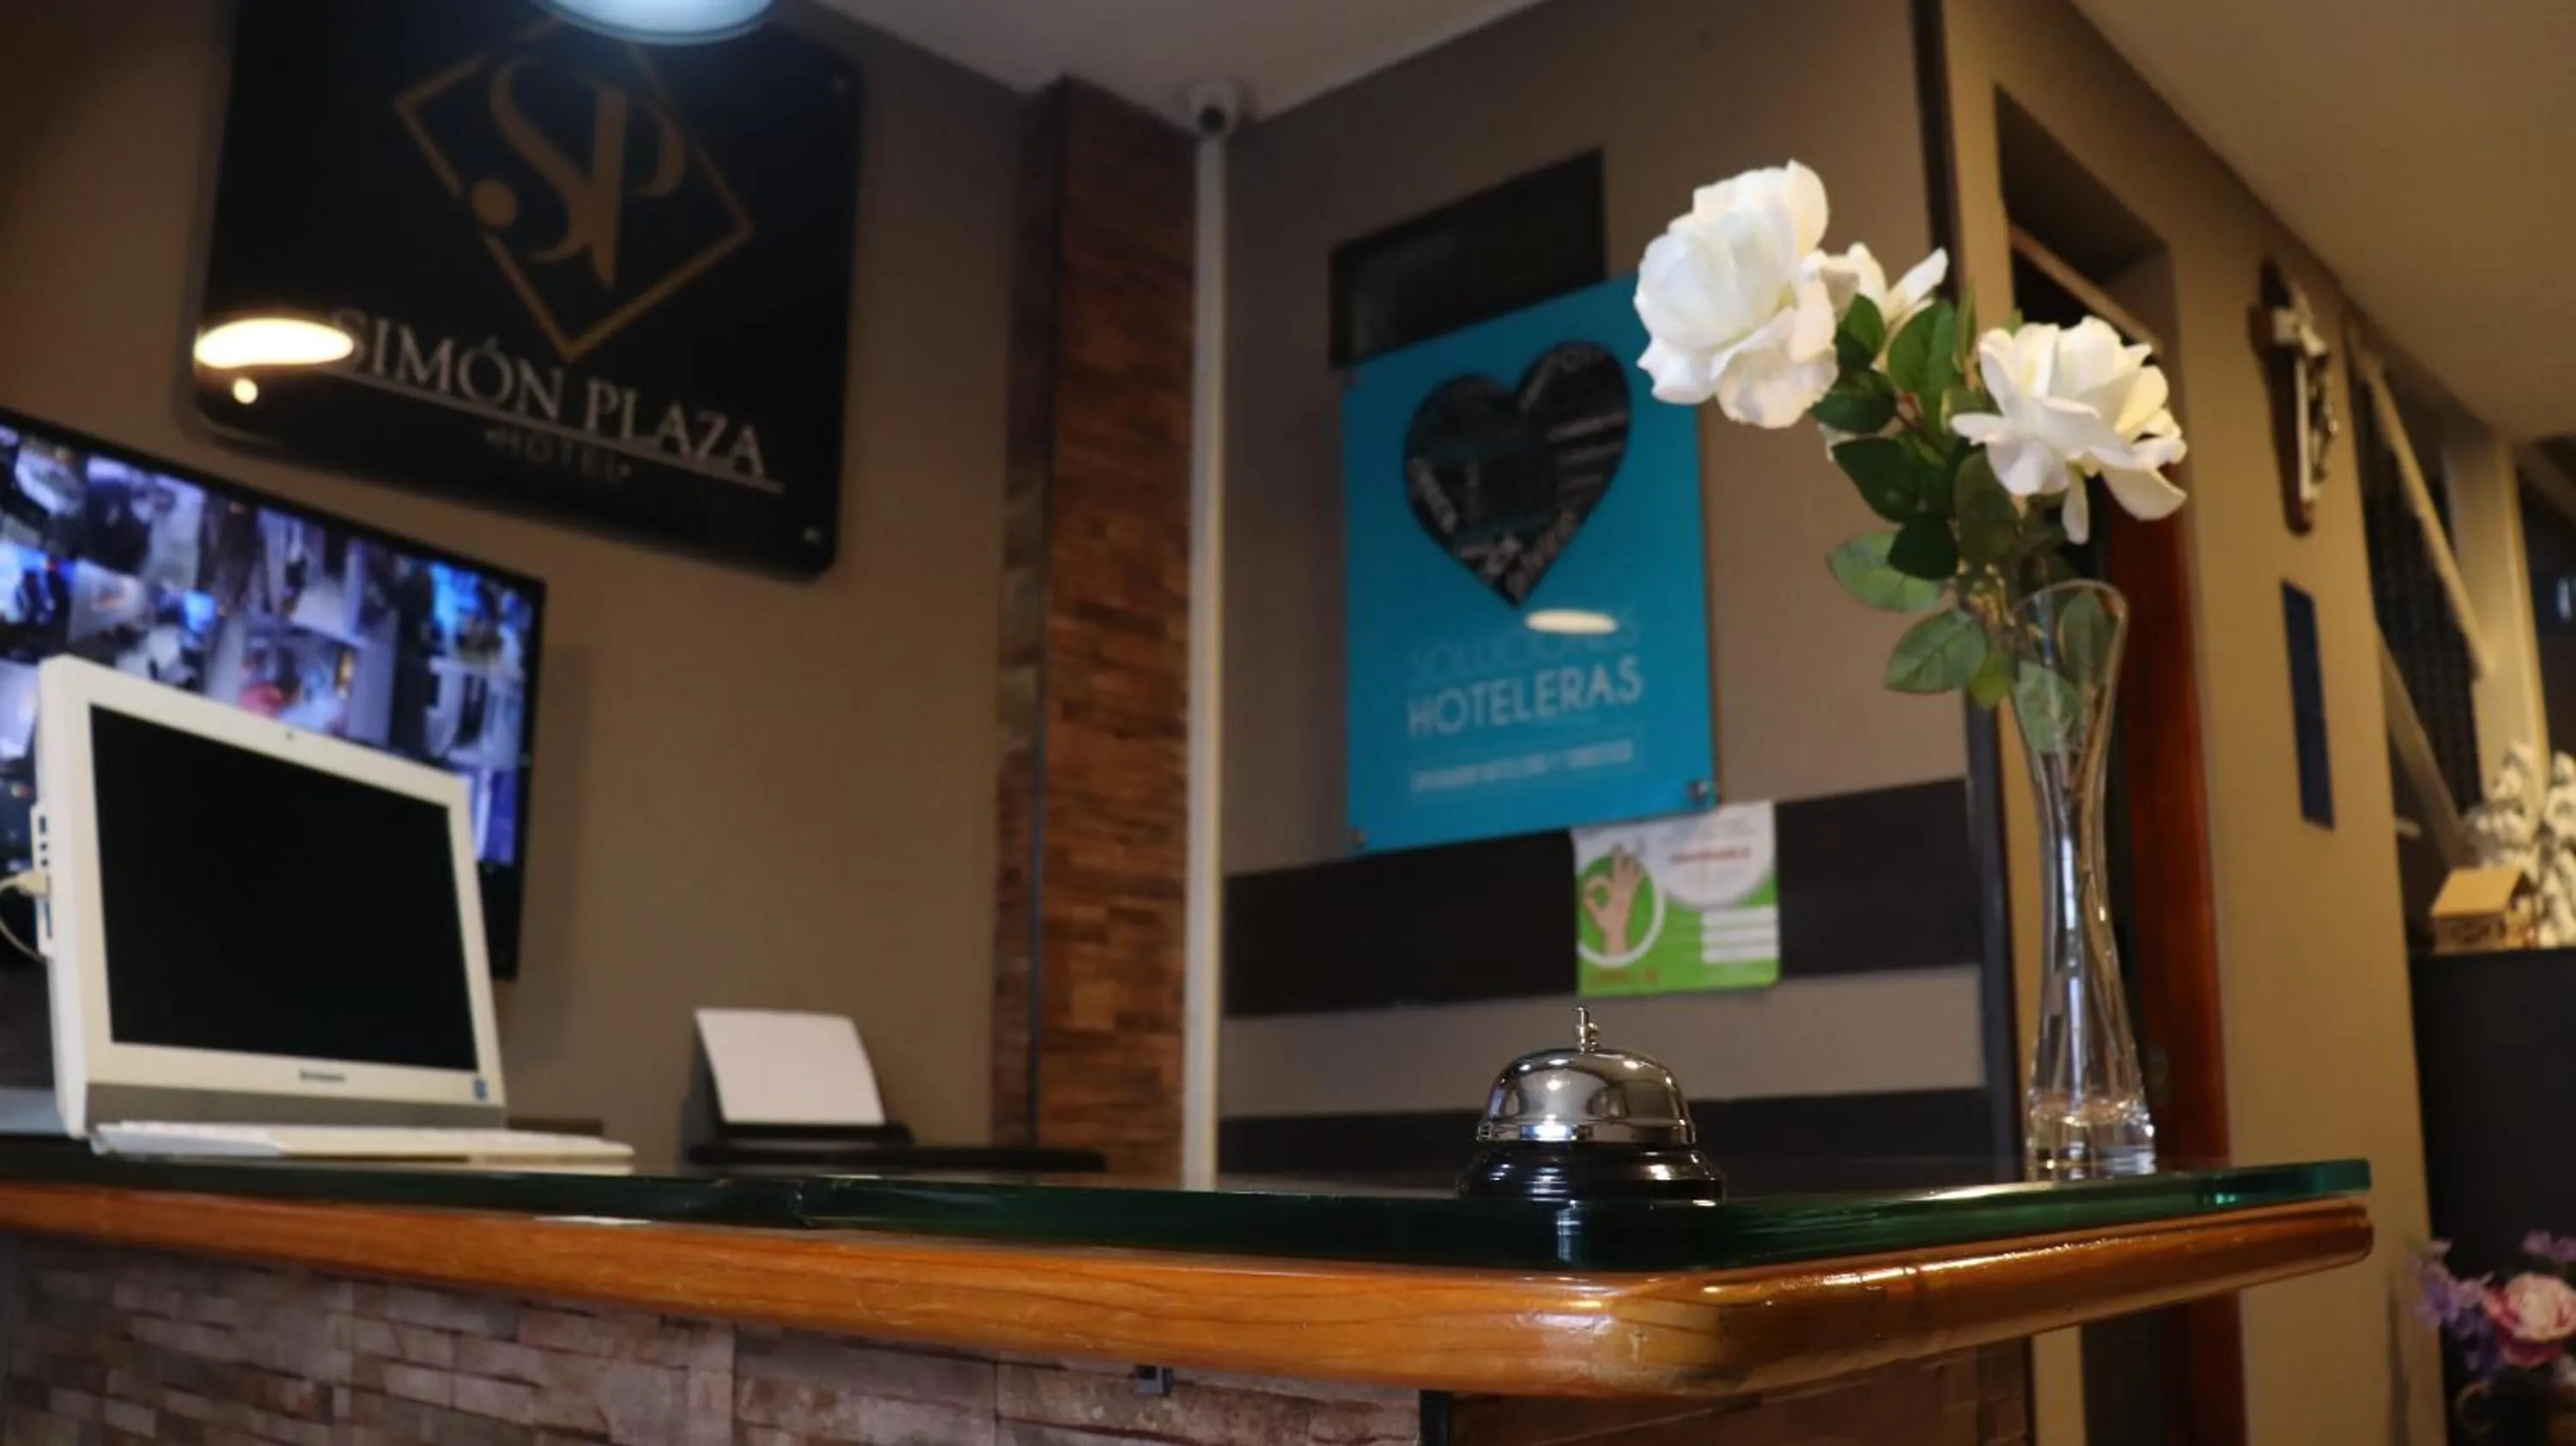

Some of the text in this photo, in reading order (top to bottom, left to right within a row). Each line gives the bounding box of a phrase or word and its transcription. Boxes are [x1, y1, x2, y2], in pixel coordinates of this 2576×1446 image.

[333, 307, 766, 479] SIMÓN PLAZA
[1406, 654, 1645, 738] HOTELERAS
